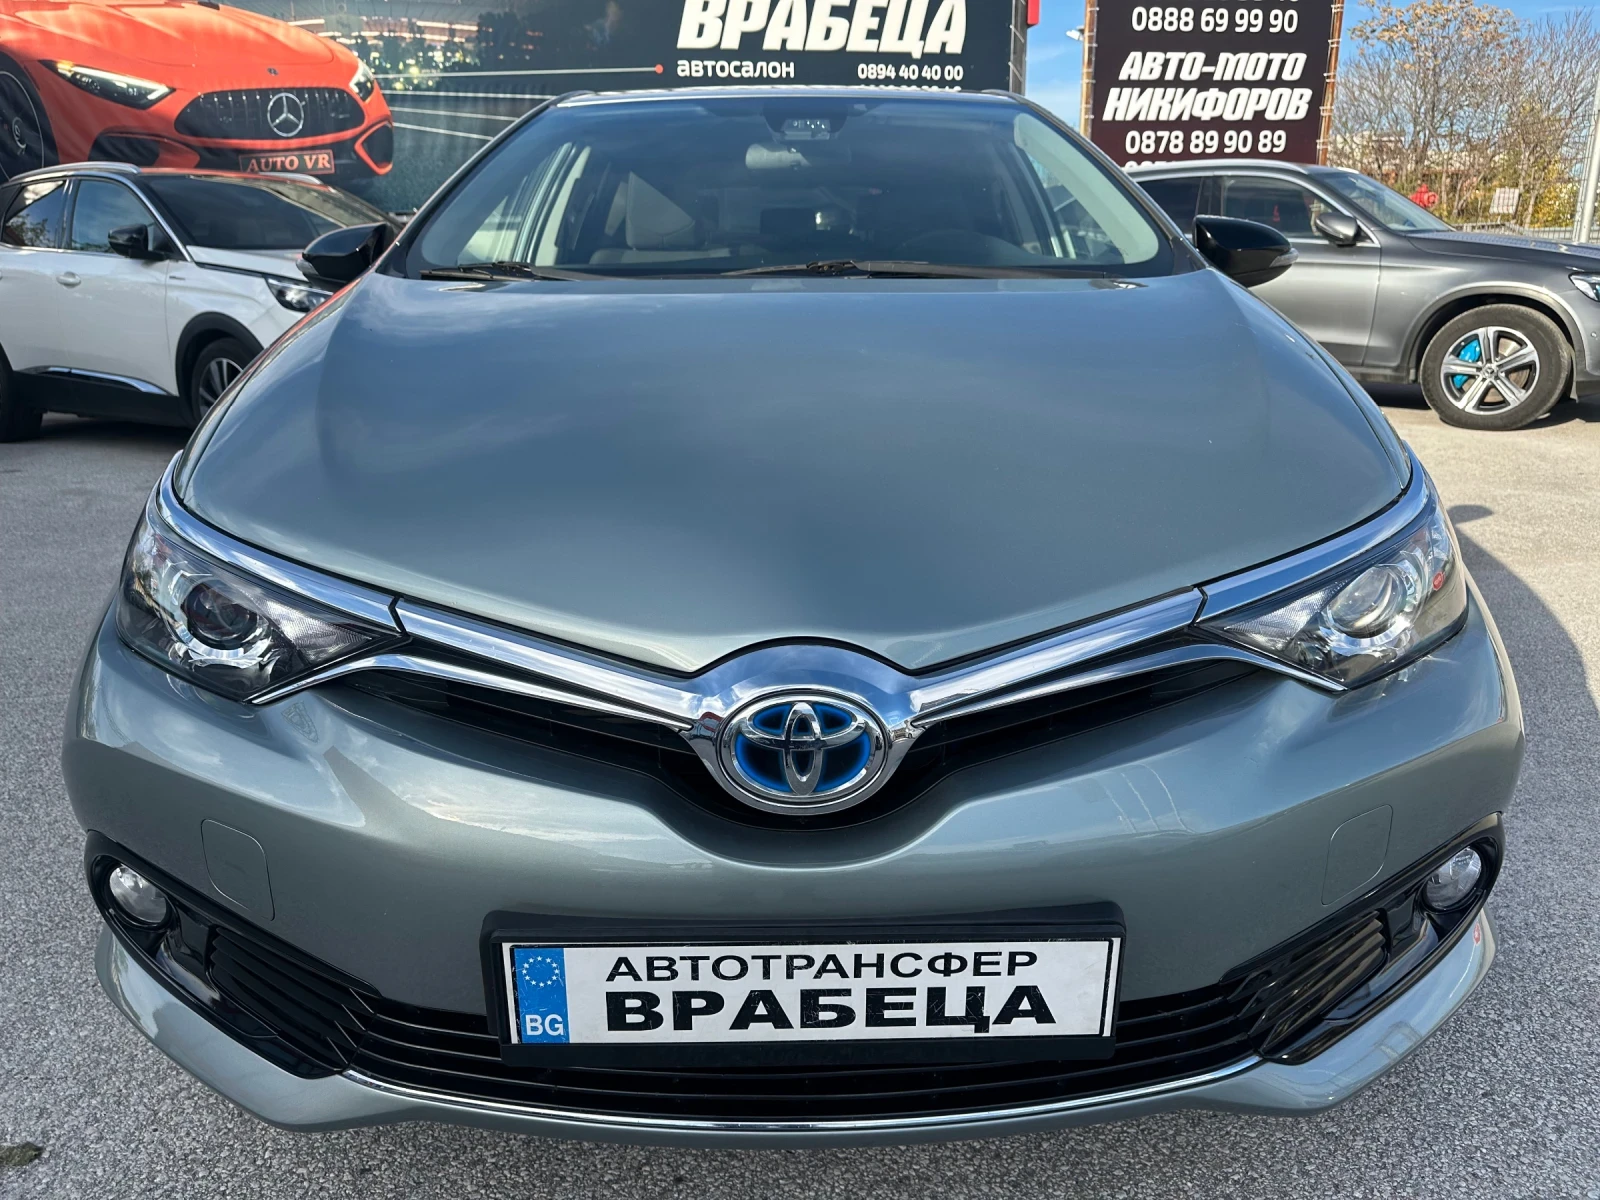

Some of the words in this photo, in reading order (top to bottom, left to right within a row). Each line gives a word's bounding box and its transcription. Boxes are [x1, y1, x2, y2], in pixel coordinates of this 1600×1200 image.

[676, 0, 967, 59] ВРАБЕЦА
[1131, 6, 1195, 32] 0888
[1200, 8, 1229, 33] 69
[1234, 8, 1264, 33] 99
[1269, 9, 1298, 33] 90
[676, 59, 795, 79] автосалон
[857, 63, 896, 80] 0894
[898, 64, 919, 80] 40
[921, 64, 942, 80] 40
[944, 64, 964, 81] 00
[1118, 51, 1307, 81] АВТО-МОТО
[1102, 87, 1313, 121] НИКИФОРОВ
[1125, 130, 1184, 154] 0878
[1189, 130, 1219, 154] 89
[1223, 130, 1253, 154] 90
[1257, 130, 1287, 153] 89
[246, 155, 299, 173] AUTO
[303, 153, 331, 170] VR
[605, 950, 1039, 982] АВТОТРАНСФЕР
[605, 985, 1057, 1034] ВРАБЕЦА
[524, 1013, 565, 1037] BG
